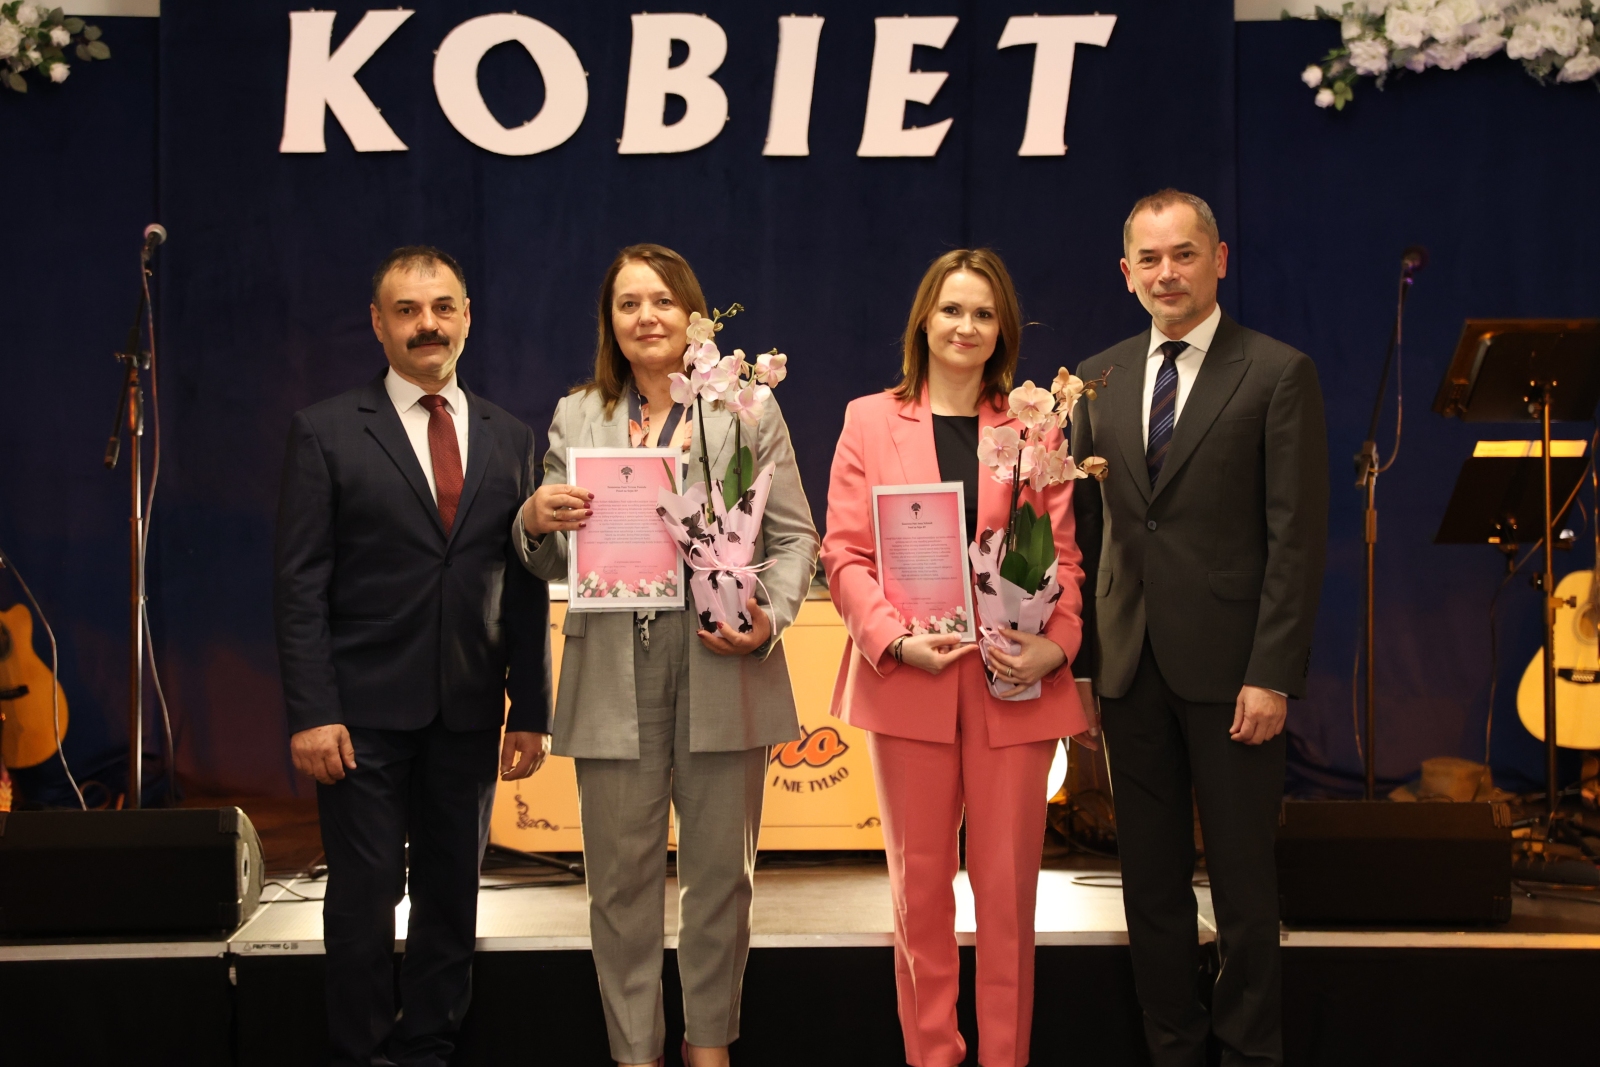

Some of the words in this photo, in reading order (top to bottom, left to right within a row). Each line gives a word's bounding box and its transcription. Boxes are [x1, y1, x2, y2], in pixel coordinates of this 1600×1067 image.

[279, 8, 1118, 157] KOBIET
[782, 779, 804, 793] NIE
[808, 767, 849, 792] TYLKO
